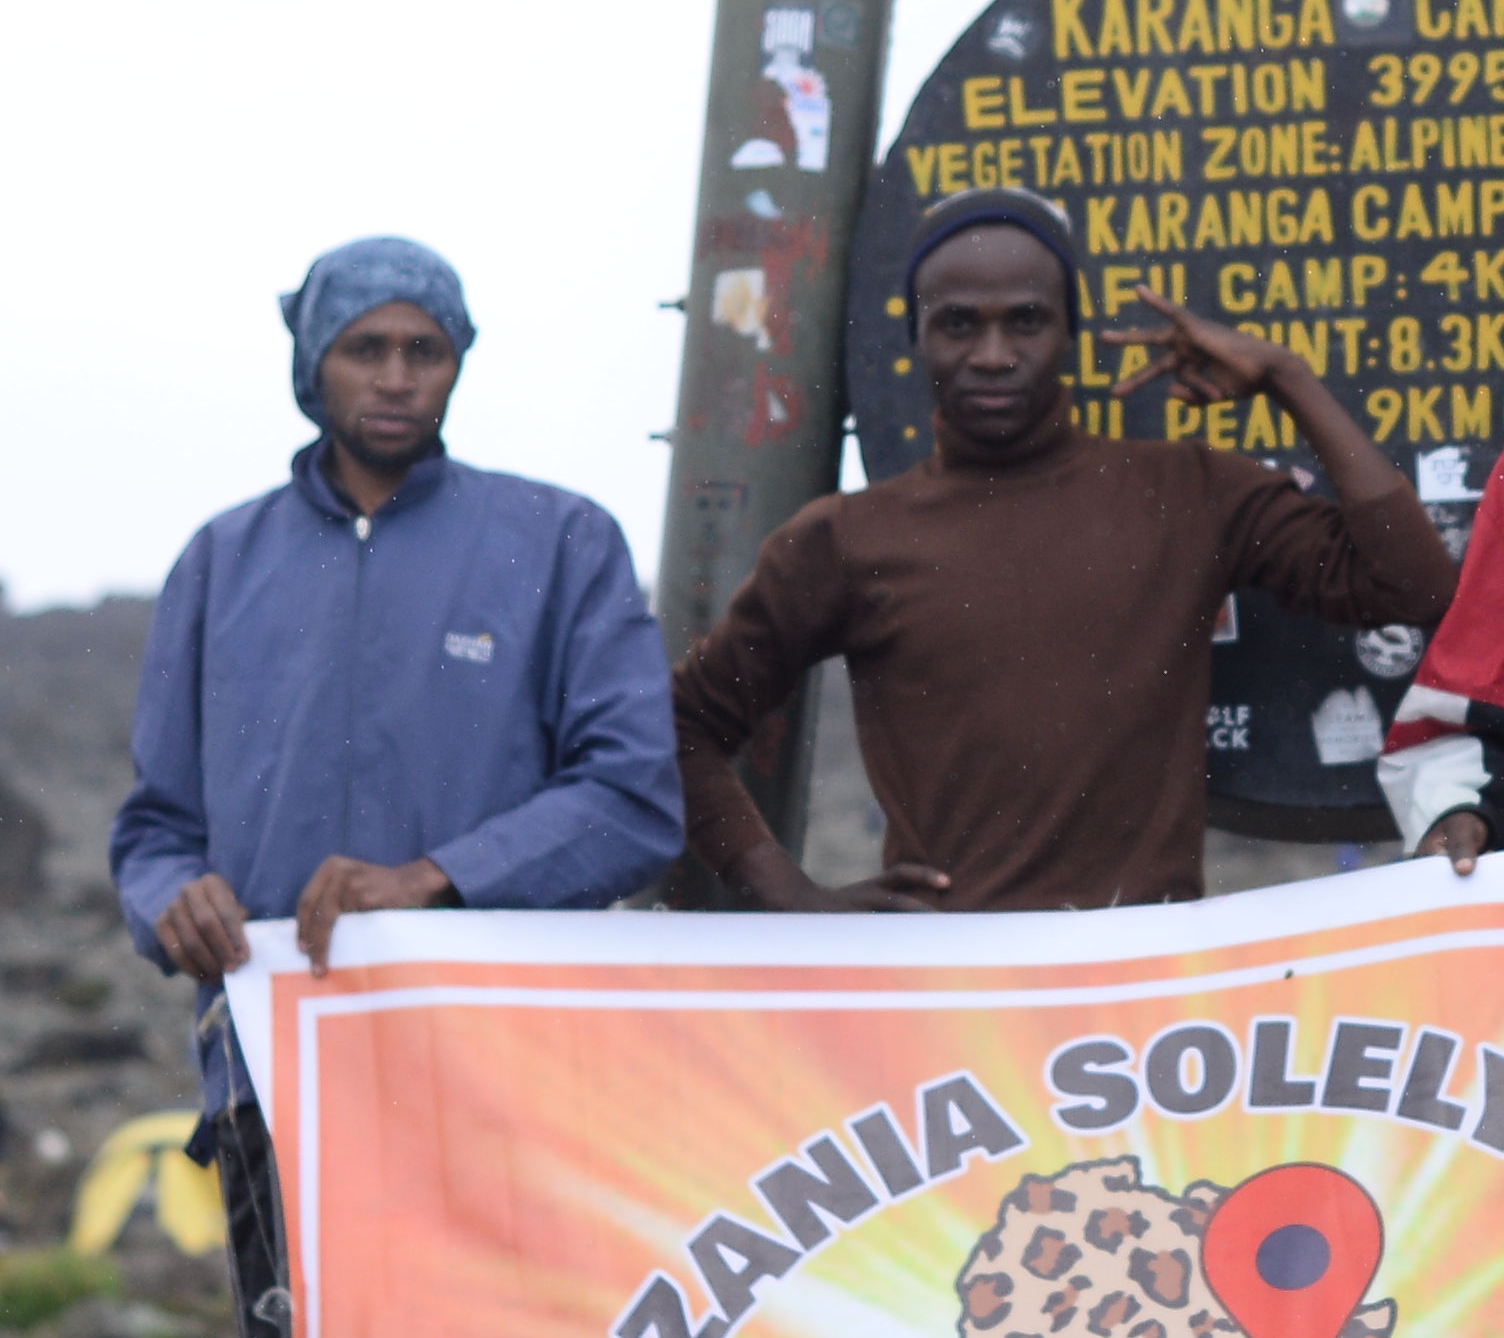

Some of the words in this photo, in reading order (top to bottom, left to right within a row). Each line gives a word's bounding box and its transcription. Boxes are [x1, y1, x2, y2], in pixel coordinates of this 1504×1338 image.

[961, 58, 1329, 132] ELEVATION
[906, 129, 1185, 198] VEGETATION
[1086, 186, 1335, 256] KARANGA
[1164, 392, 1296, 450] PEA
